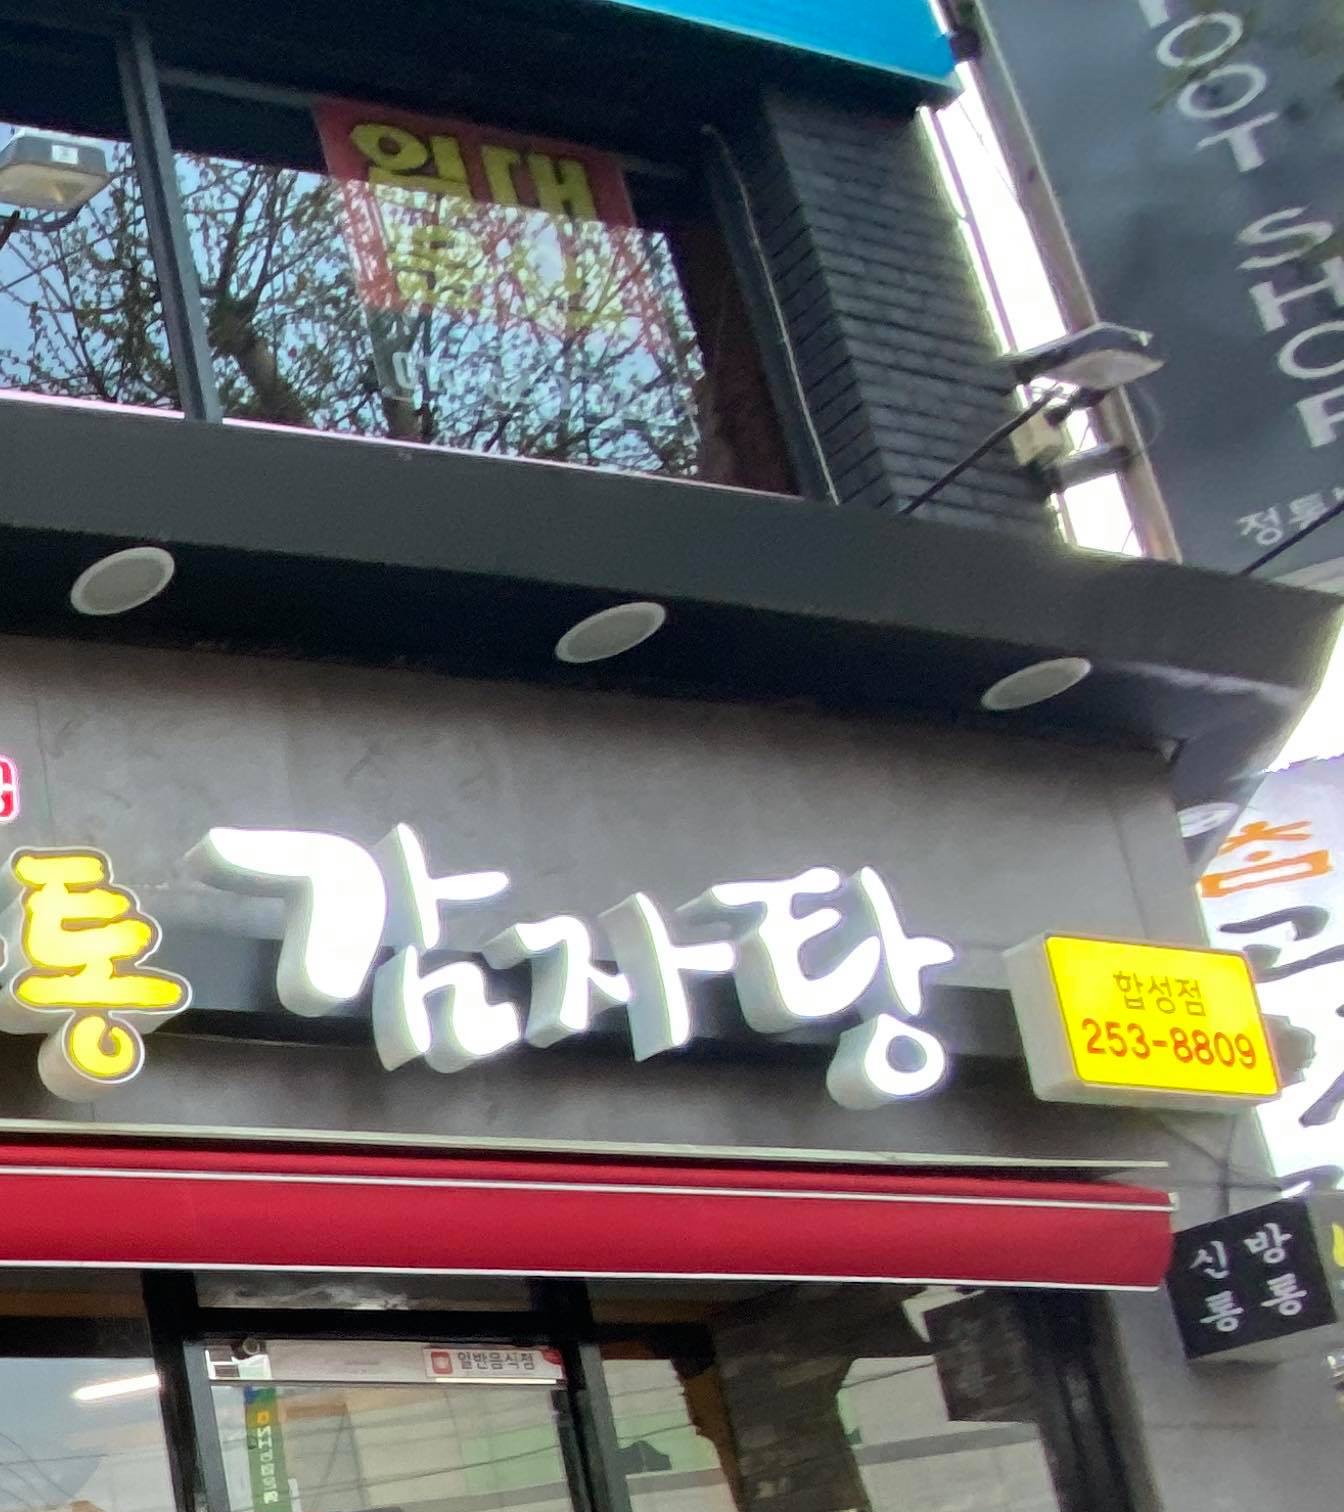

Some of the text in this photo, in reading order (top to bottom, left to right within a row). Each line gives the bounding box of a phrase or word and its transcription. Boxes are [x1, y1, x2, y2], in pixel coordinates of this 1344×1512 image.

[1141, 0, 1280, 172] OOT
[192, 822, 955, 1107] 감자탕
[1113, 971, 1207, 1017] 합성점
[1082, 1017, 1257, 1070] 253-8809
